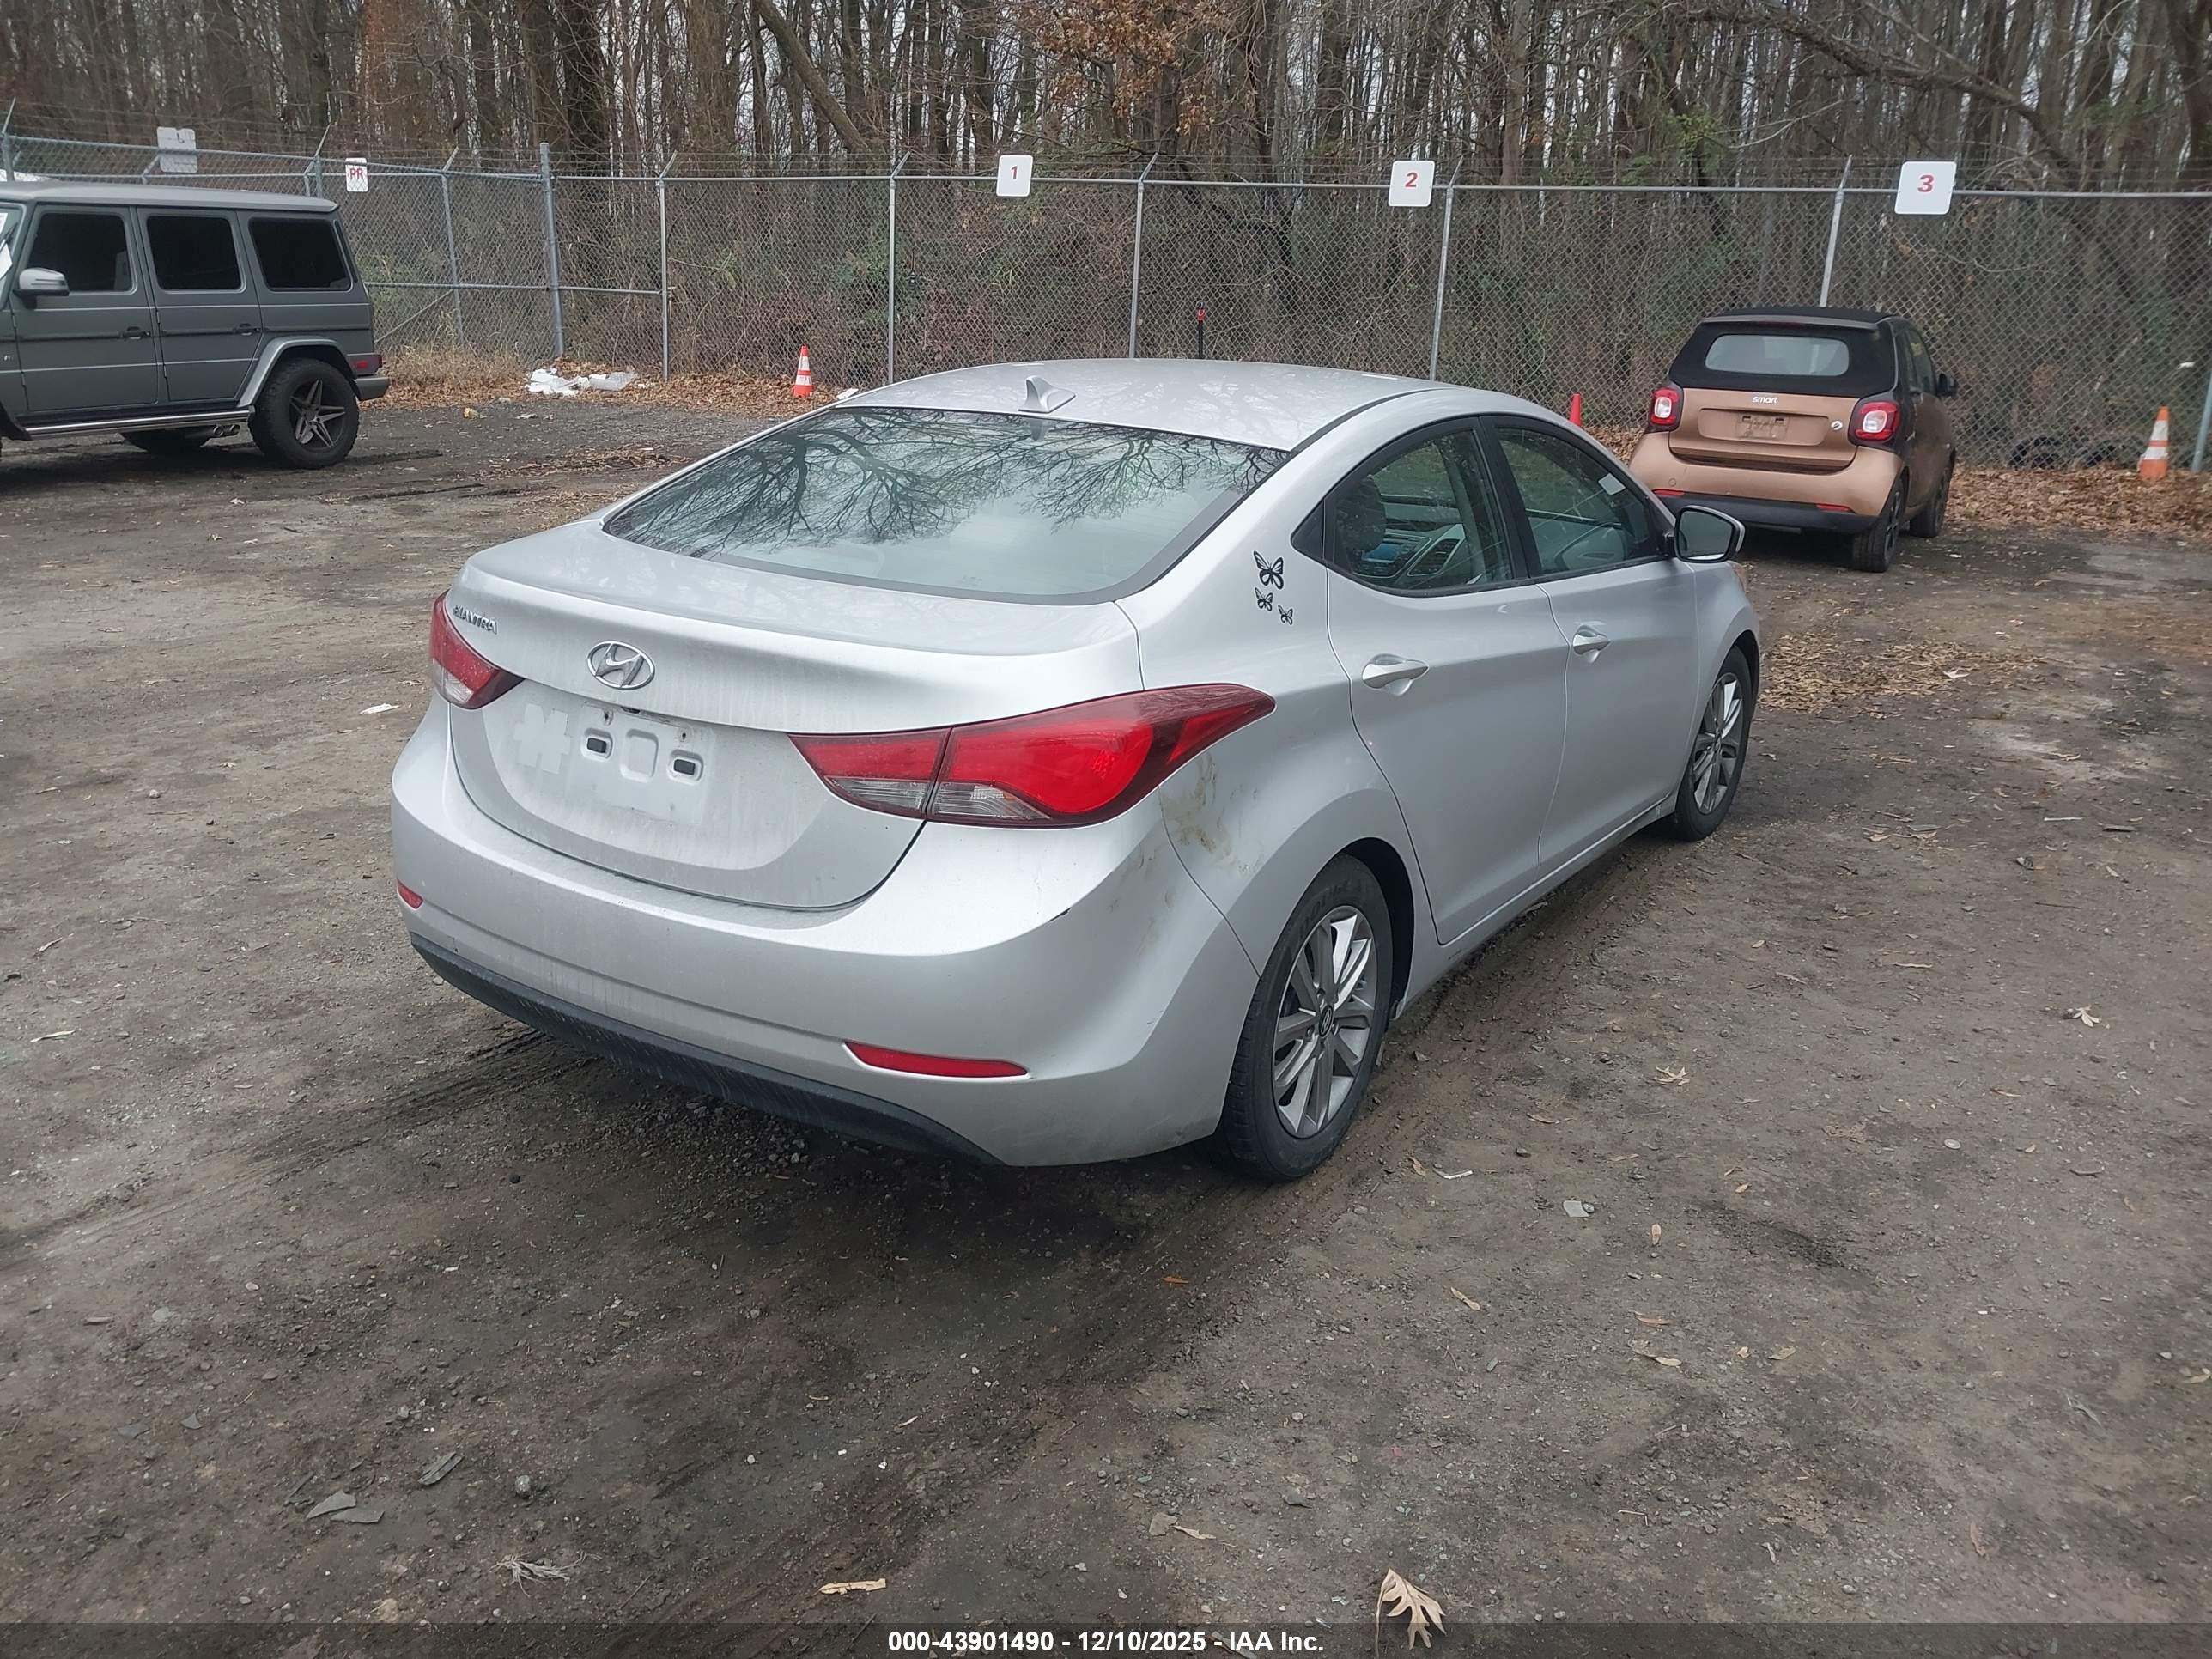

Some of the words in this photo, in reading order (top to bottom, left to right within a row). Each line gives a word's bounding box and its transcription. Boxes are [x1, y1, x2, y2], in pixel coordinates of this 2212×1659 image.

[1011, 165, 1018, 179] 1
[1405, 172, 1418, 188] 2
[1917, 174, 1935, 193] 3
[1752, 396, 1778, 404] smart
